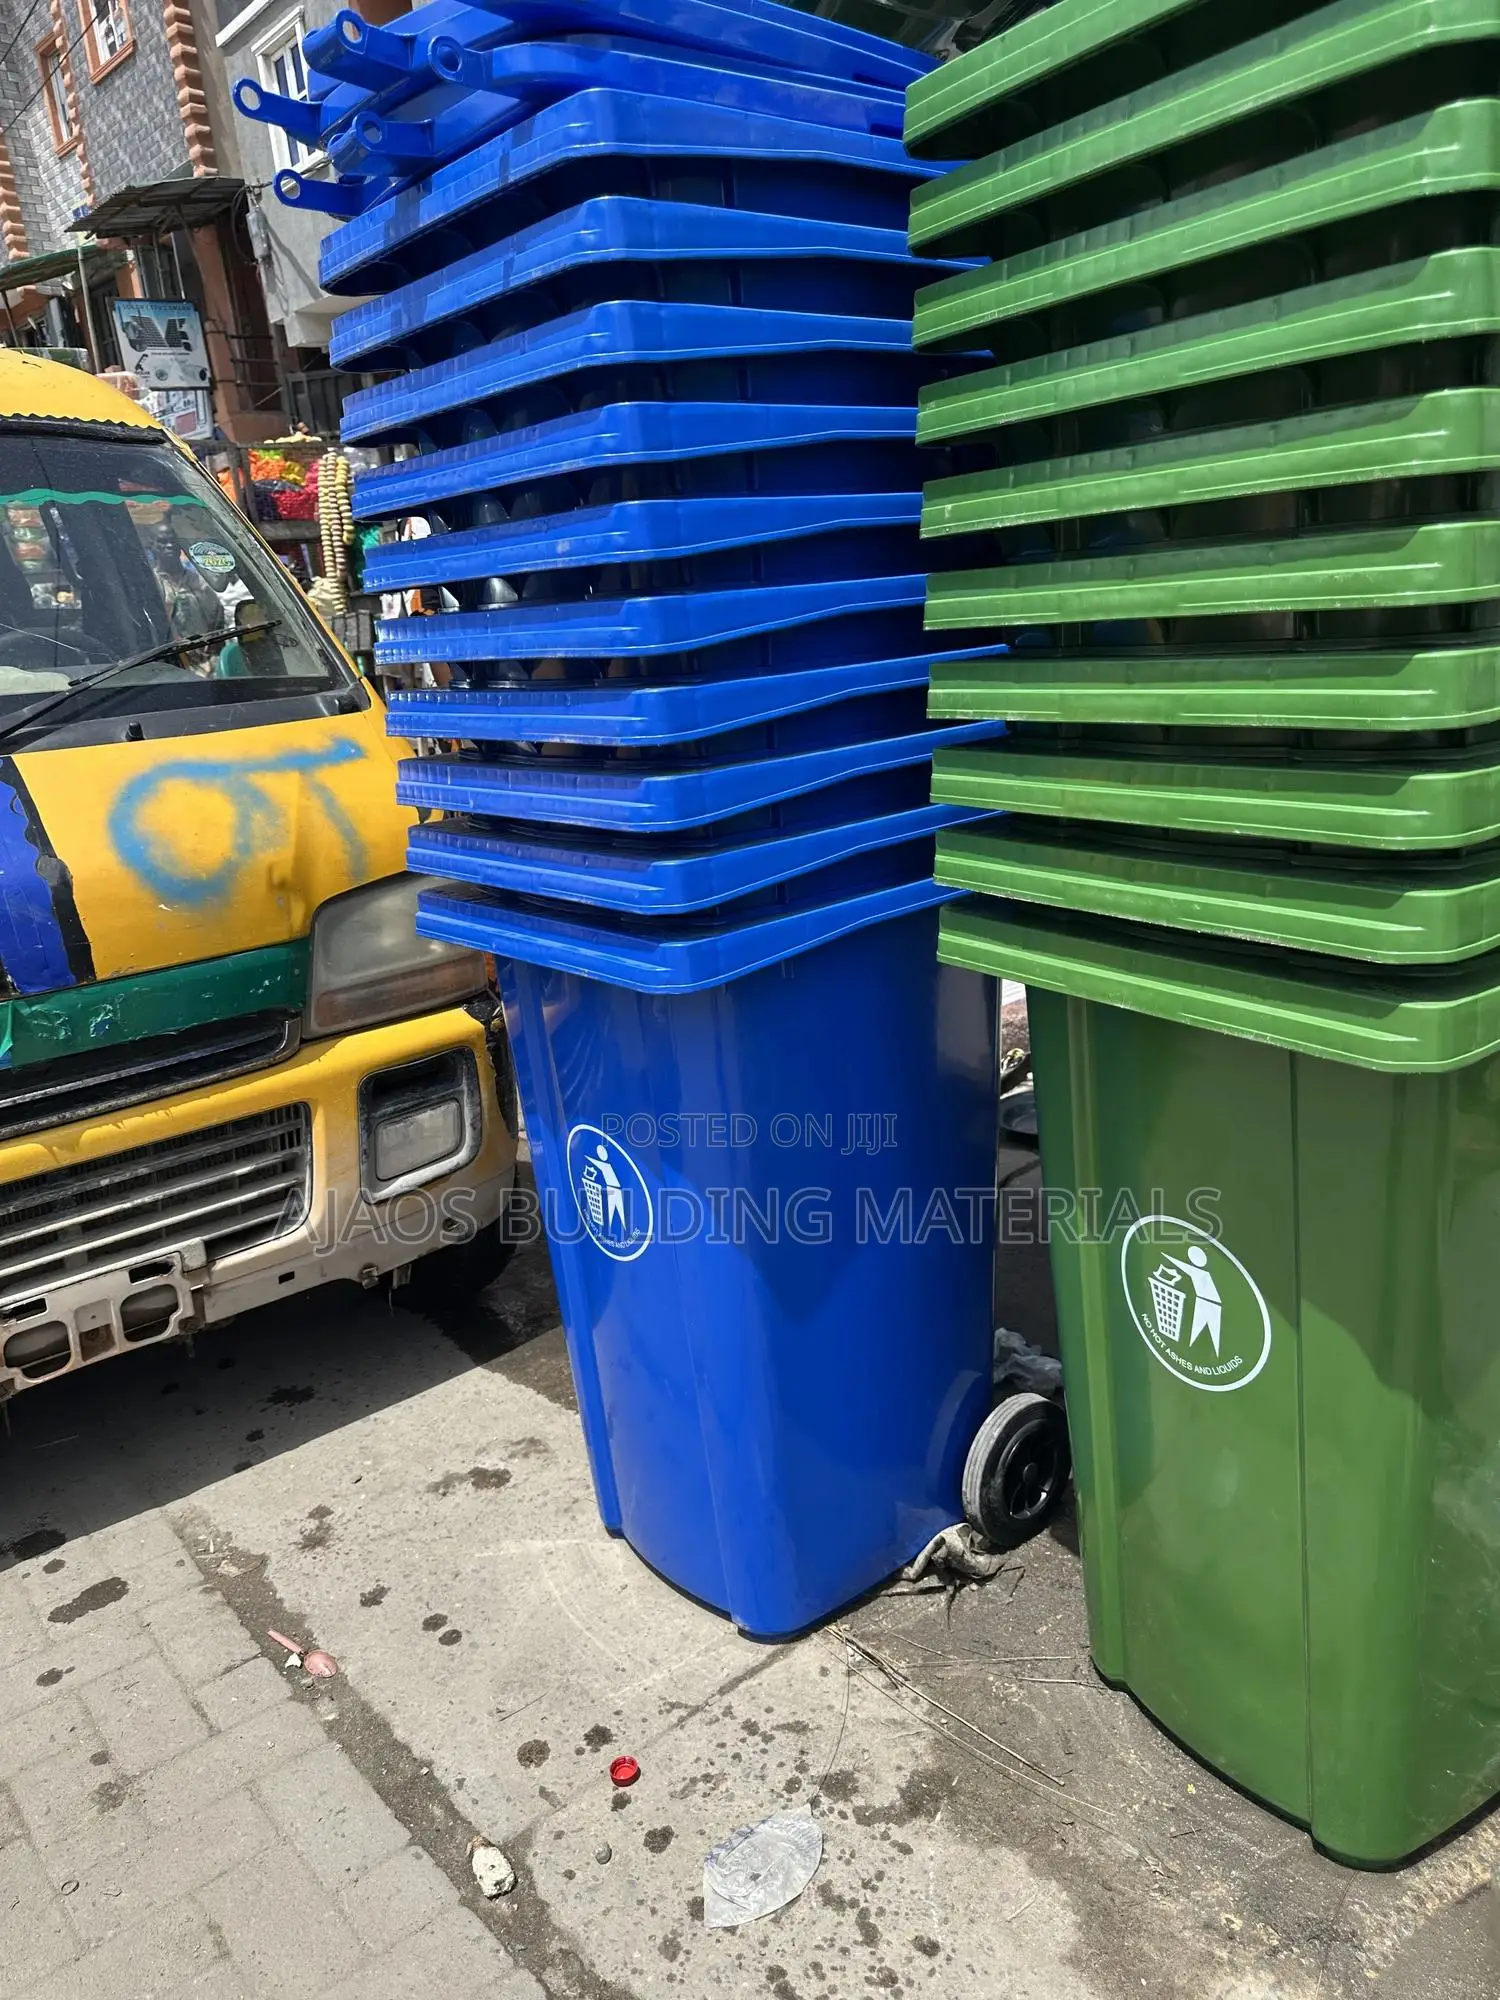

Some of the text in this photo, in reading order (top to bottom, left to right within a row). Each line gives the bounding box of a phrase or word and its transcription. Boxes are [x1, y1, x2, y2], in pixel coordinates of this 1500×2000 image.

[1141, 1313, 1243, 1376] NO HOT ASHES AND LIQUIDS
